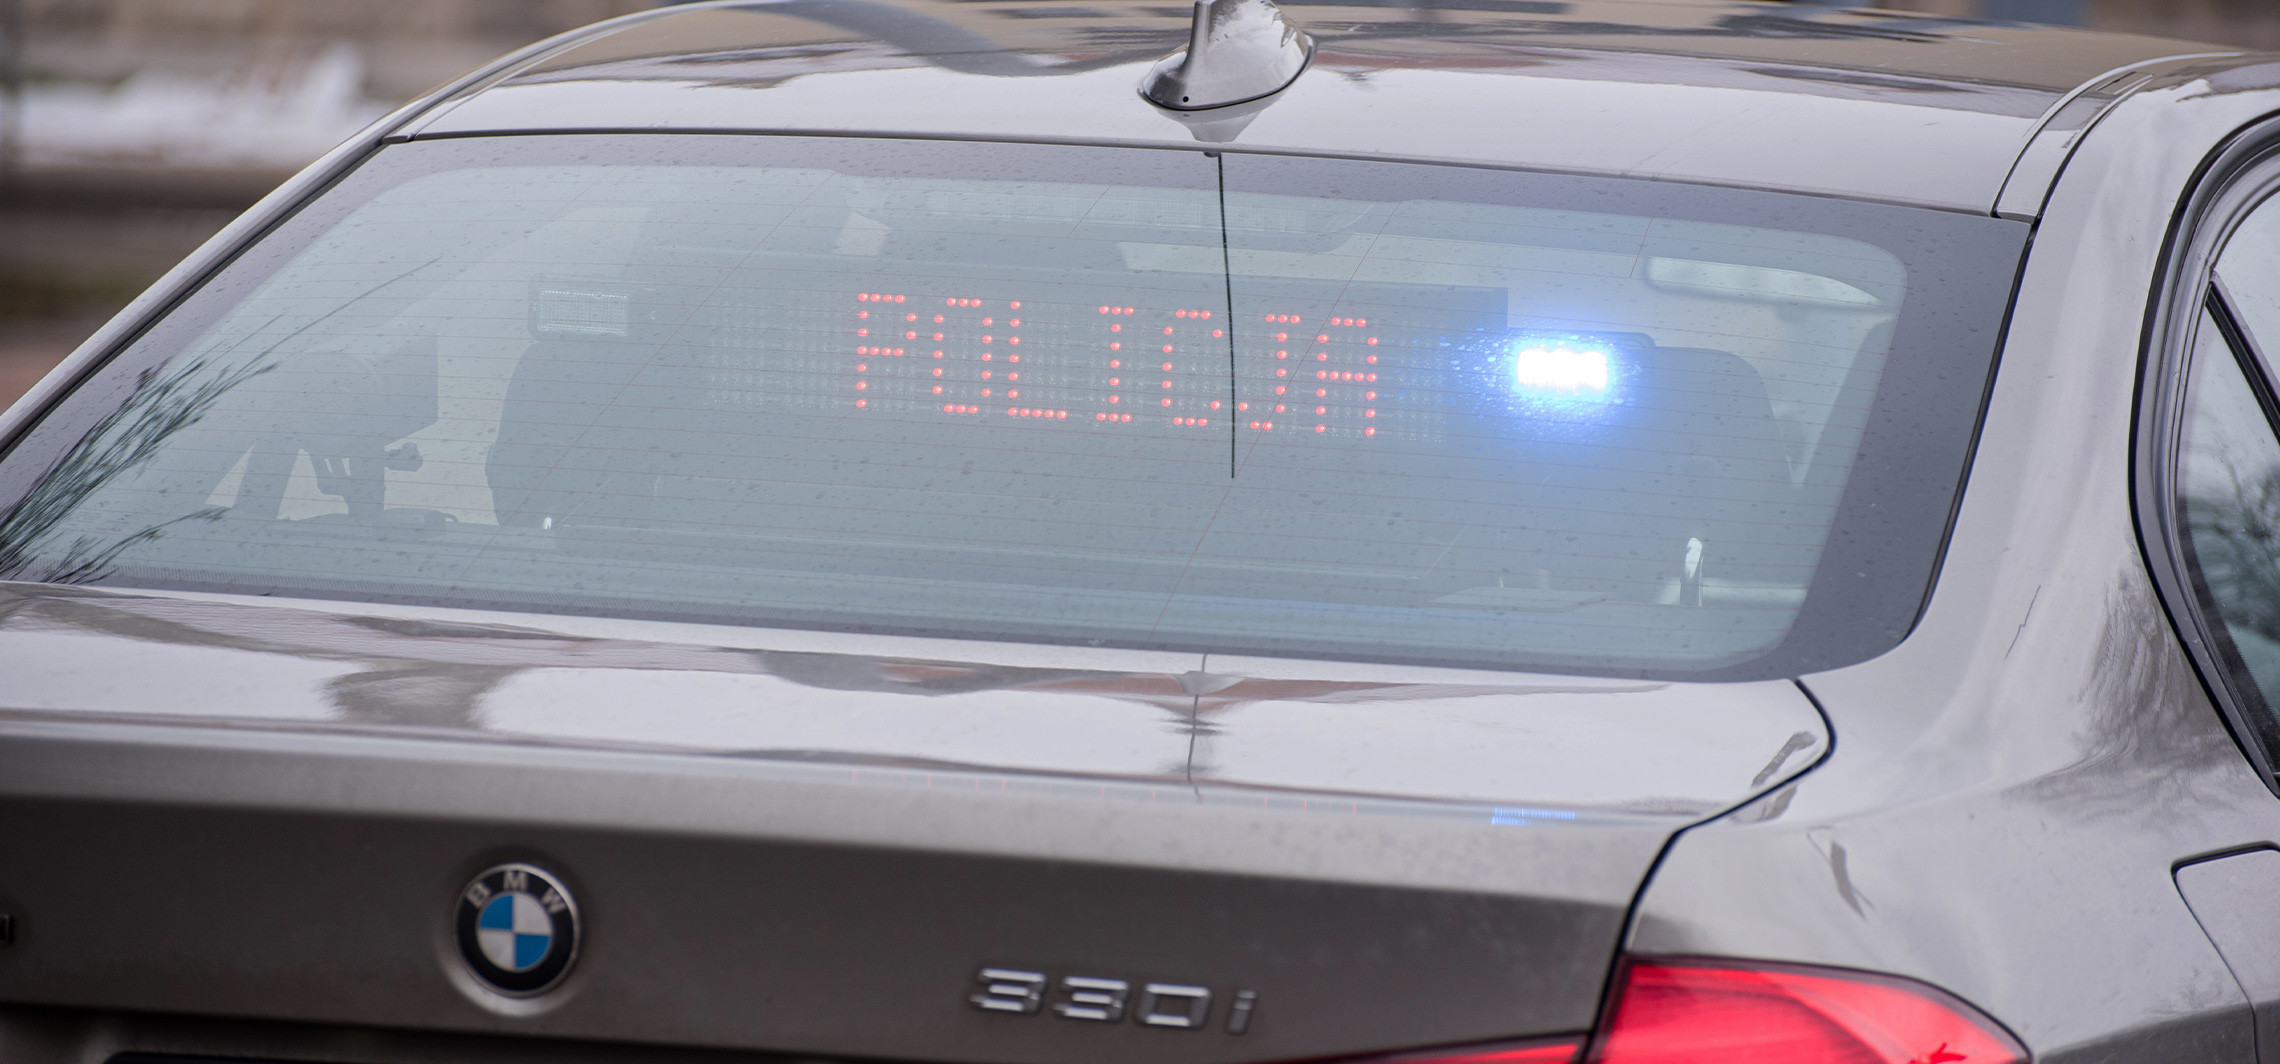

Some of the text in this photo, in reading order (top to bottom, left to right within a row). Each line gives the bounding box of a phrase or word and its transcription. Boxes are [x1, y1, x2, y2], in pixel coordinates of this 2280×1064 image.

[856, 291, 1379, 437] POLICJA
[465, 869, 567, 914] BMW
[969, 967, 1257, 1034] 330i
